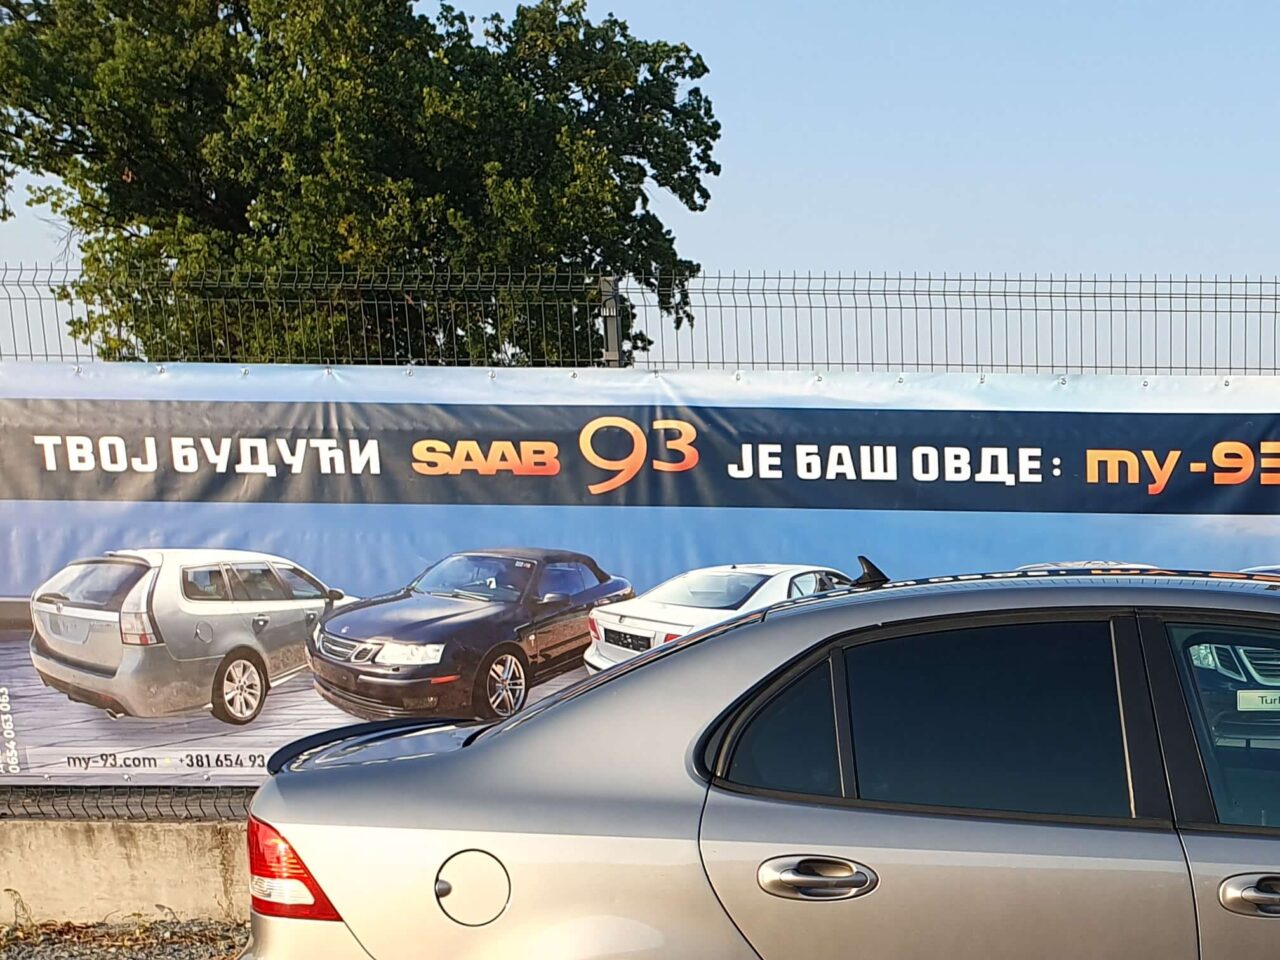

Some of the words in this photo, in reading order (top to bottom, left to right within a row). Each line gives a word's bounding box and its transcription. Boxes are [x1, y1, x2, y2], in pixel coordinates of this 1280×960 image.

[33, 434, 158, 473] ТВОЈ
[170, 437, 382, 477] БУДУЋИ
[411, 438, 561, 476] SAAB
[578, 415, 700, 494] 93
[726, 442, 783, 479] ЈЕ
[795, 444, 898, 481] БАШ
[1, 714, 15, 738] 063
[5, 740, 20, 773] 0654
[67, 754, 157, 770] my-93.com
[248, 754, 265, 768] 93
